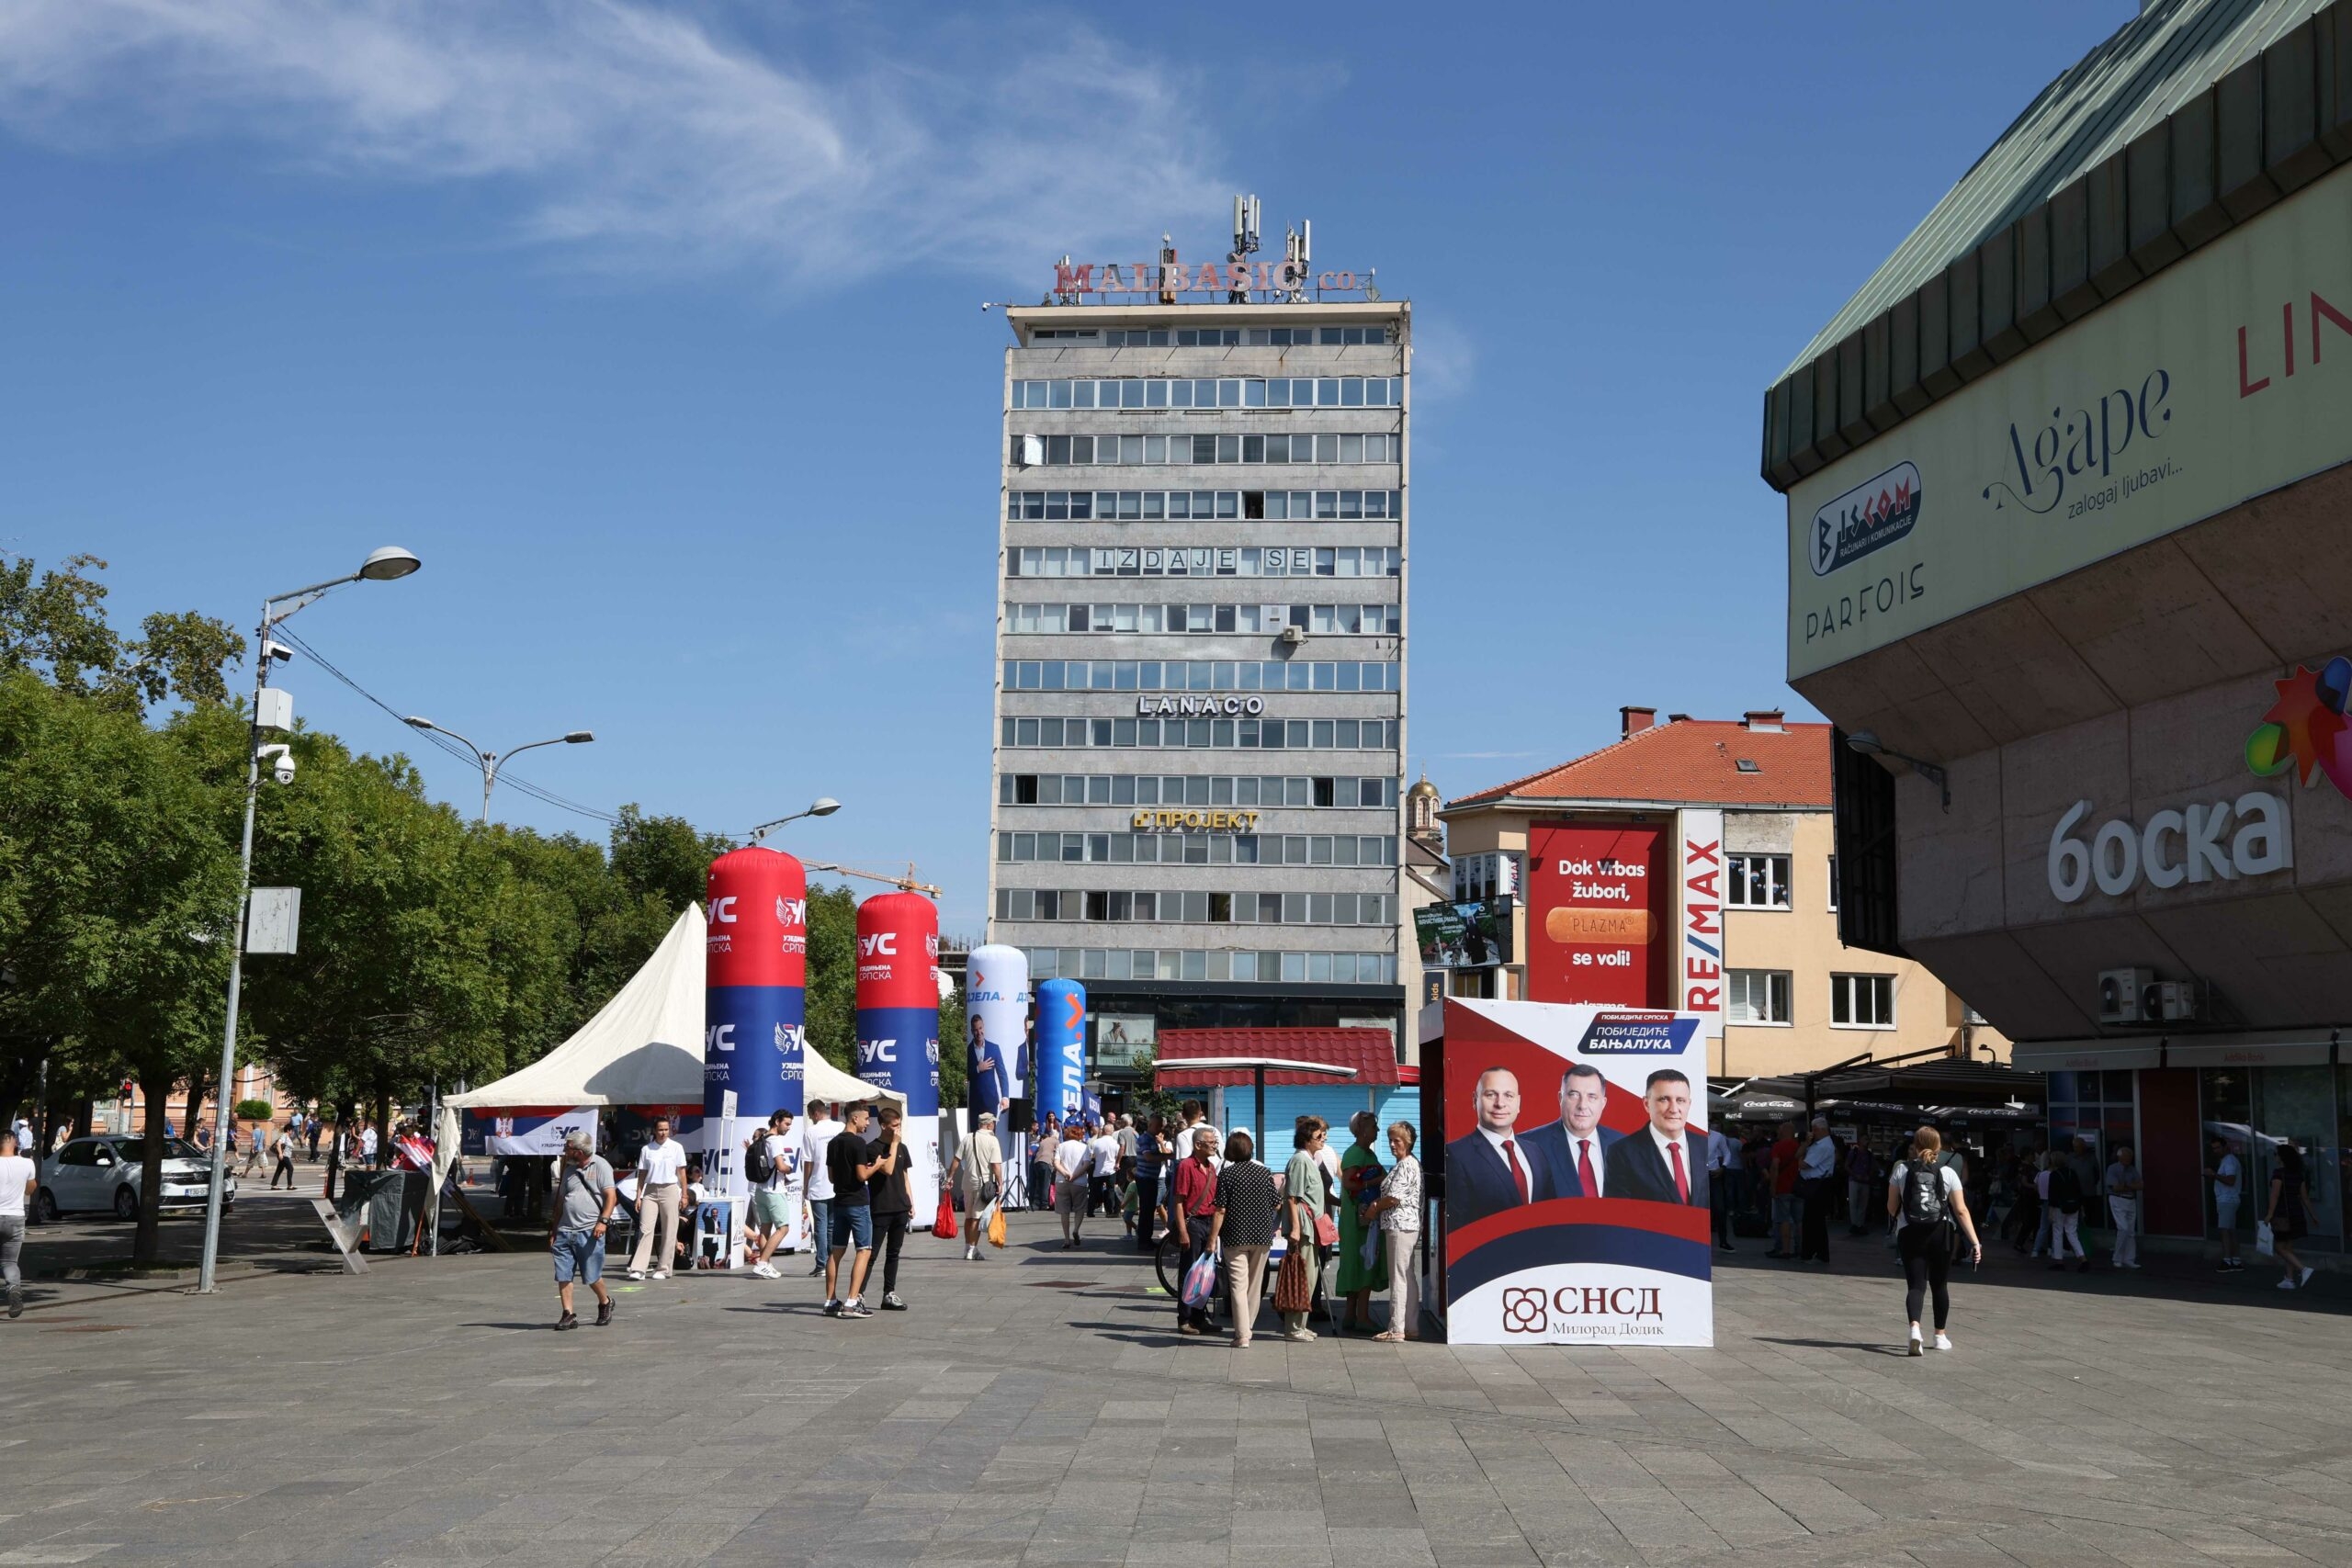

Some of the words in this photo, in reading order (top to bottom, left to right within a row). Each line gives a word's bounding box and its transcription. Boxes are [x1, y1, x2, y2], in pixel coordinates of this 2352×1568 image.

[1983, 369, 2171, 513] Agape
[2068, 480, 2118, 519] zalogaj
[1818, 476, 1911, 570] BISCOM
[1871, 514, 1912, 543] KOMUNIKACIJE
[1102, 550, 1233, 568] IZDAJE
[1269, 549, 1306, 568] SE
[1806, 562, 1925, 644] PARFOIS
[1139, 695, 1263, 715] LANACO
[1156, 810, 1258, 828] ПРОЈЕКТ
[2047, 791, 2293, 903] боска
[1558, 859, 1593, 875] Dok
[1597, 860, 1645, 877] Vrbas
[1572, 881, 1631, 901] žubori,
[1686, 839, 1720, 1010] RE/MAX
[1572, 953, 1592, 965] se
[1597, 950, 1631, 966] voli!
[1596, 1026, 1670, 1037] ПОБИЈЕДИЋЕ
[1589, 1039, 1672, 1049] БАЊАЛУКА
[861, 1077, 892, 1088] ПСКА
[1553, 1287, 1662, 1321] СНСД
[1553, 1322, 1617, 1337] Милорад
[1620, 1323, 1665, 1336] Додик
